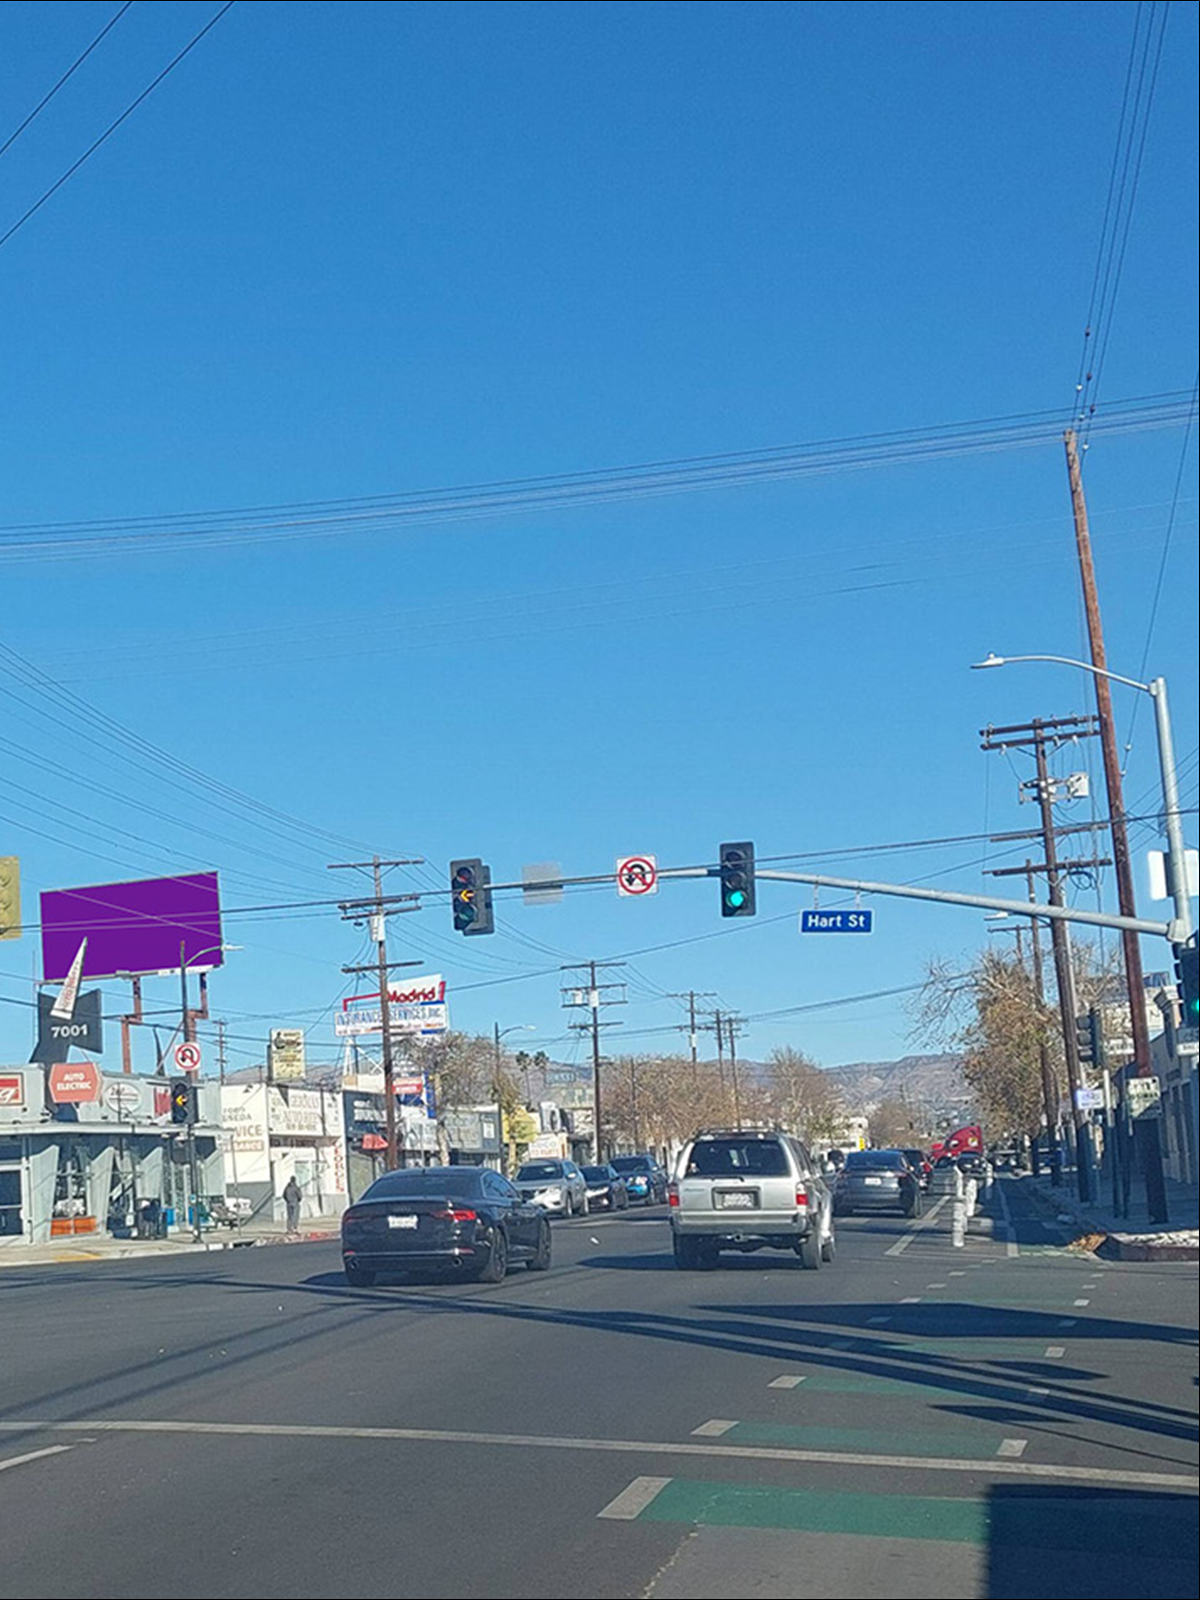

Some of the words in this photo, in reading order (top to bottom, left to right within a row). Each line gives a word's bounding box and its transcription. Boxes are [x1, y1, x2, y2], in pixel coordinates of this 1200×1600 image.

[808, 914, 842, 928] Hart
[848, 914, 865, 928] St
[50, 1024, 88, 1038] 7001
[63, 1072, 85, 1081] AUTO
[56, 1081, 92, 1091] ELECTRIC
